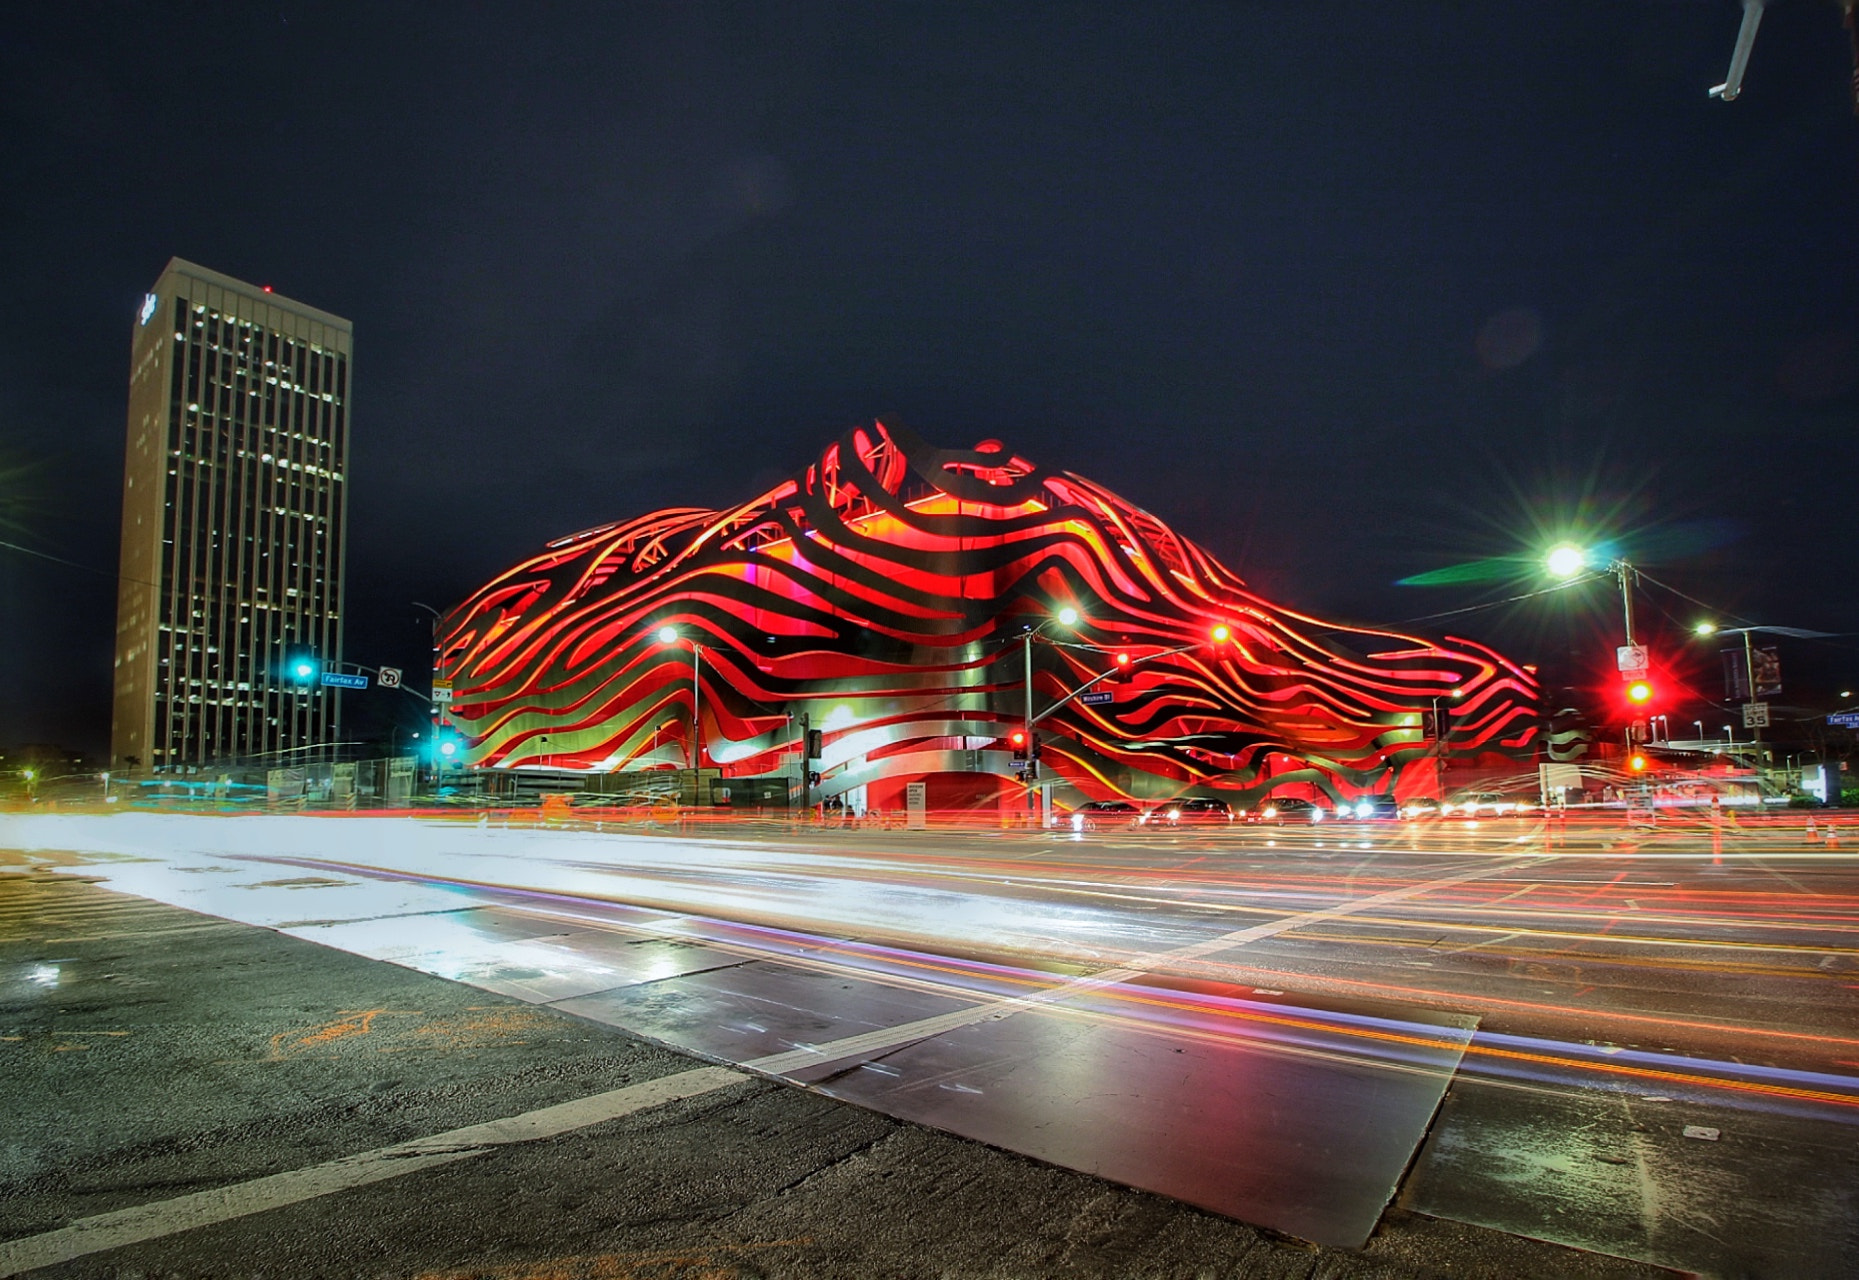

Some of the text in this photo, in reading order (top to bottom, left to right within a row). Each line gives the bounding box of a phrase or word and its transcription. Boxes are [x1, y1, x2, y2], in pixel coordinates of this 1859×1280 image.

[325, 675, 365, 686] Fairfax Av
[1746, 716, 1766, 726] 35
[1830, 716, 1853, 724] Fairfax
